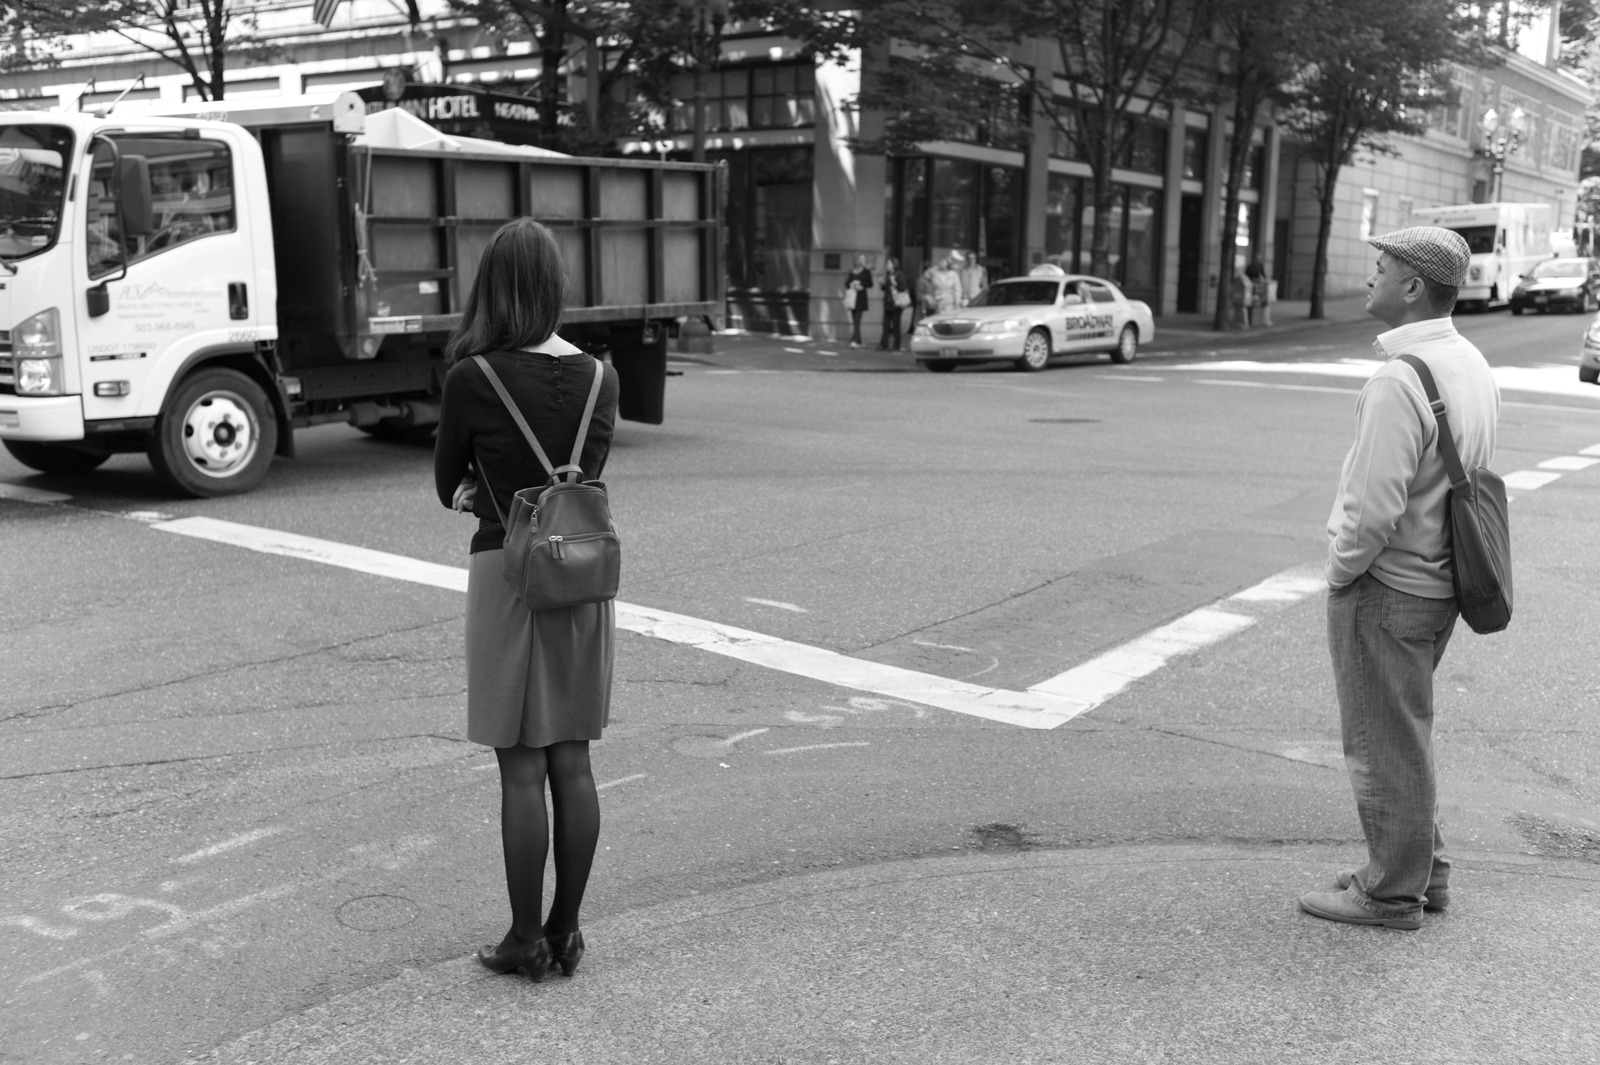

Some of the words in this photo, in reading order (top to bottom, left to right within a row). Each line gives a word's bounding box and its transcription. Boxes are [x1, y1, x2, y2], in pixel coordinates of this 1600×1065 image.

[428, 95, 480, 120] HOTEL
[1065, 314, 1114, 331] BROADWAY
[87, 343, 119, 353] USDOT
